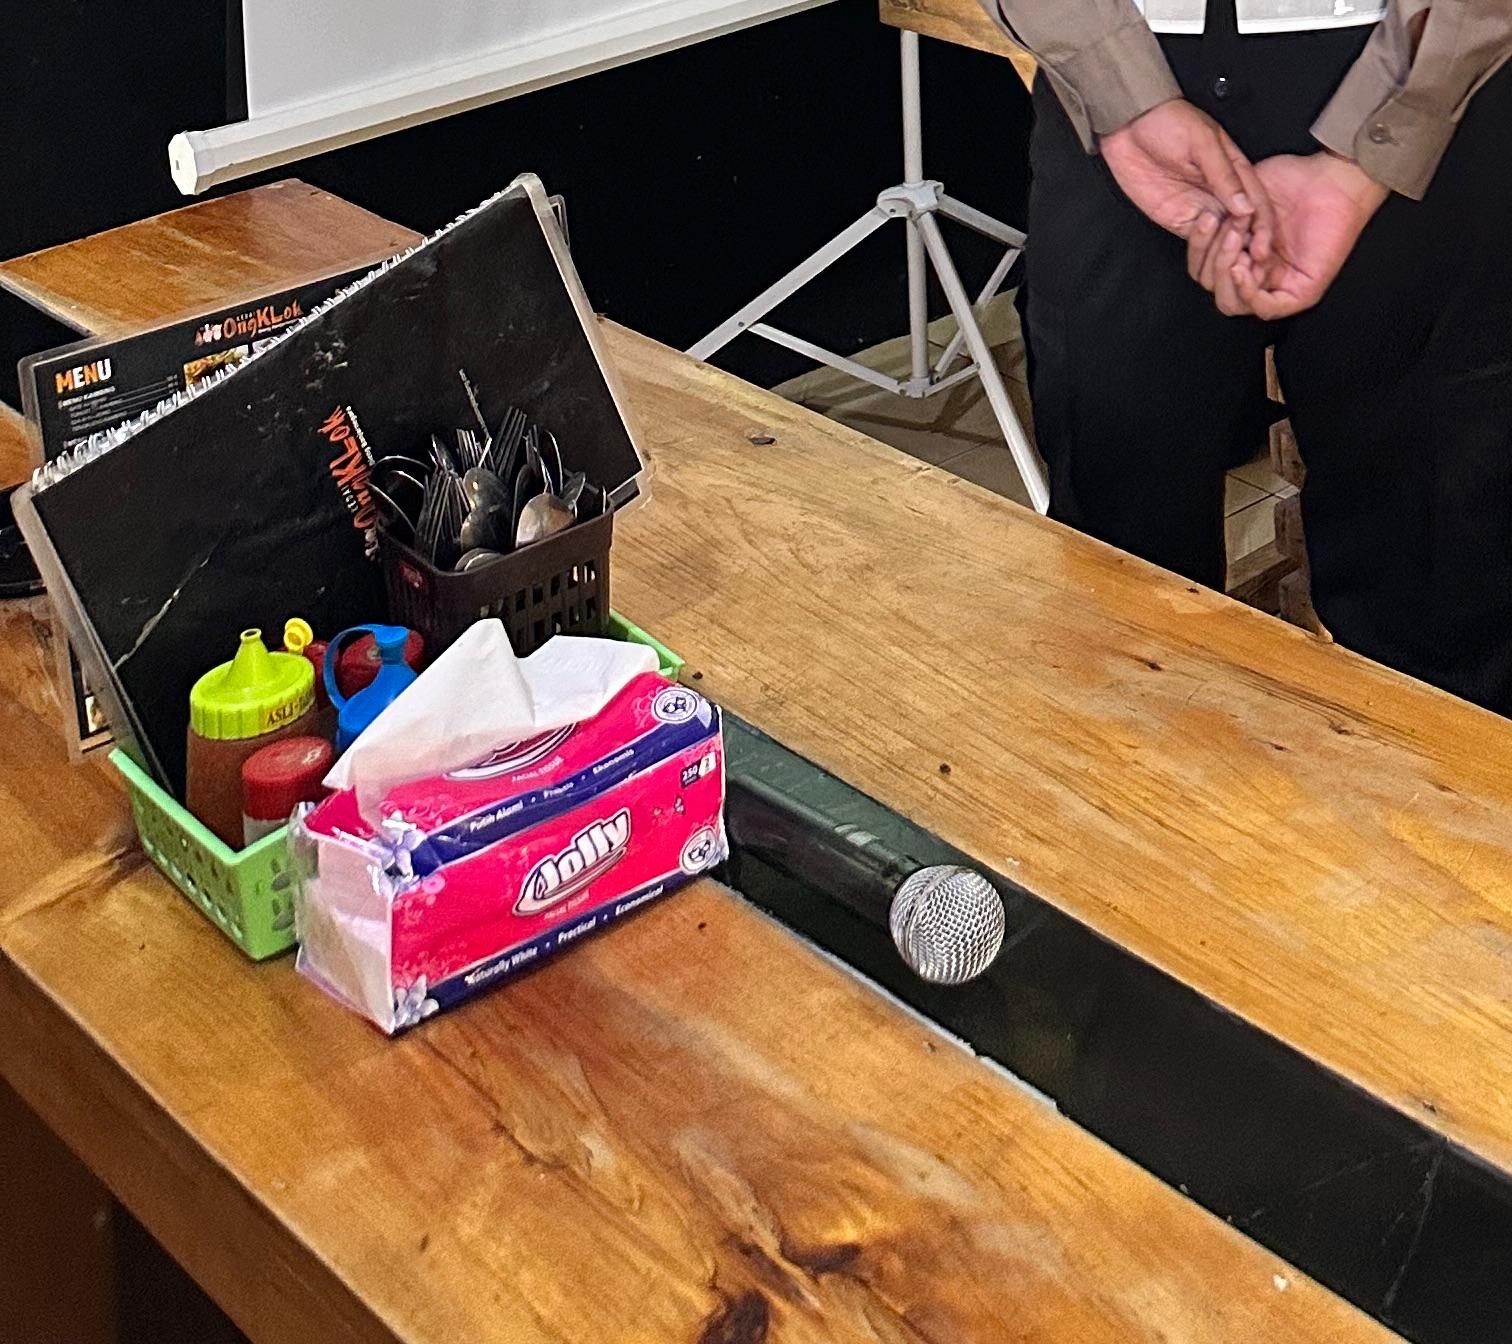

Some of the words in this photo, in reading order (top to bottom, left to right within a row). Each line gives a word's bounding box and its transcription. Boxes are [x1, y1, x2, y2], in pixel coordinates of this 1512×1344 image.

[55, 357, 112, 394] MENU
[682, 764, 699, 781] 250
[535, 812, 630, 899] Jolly
